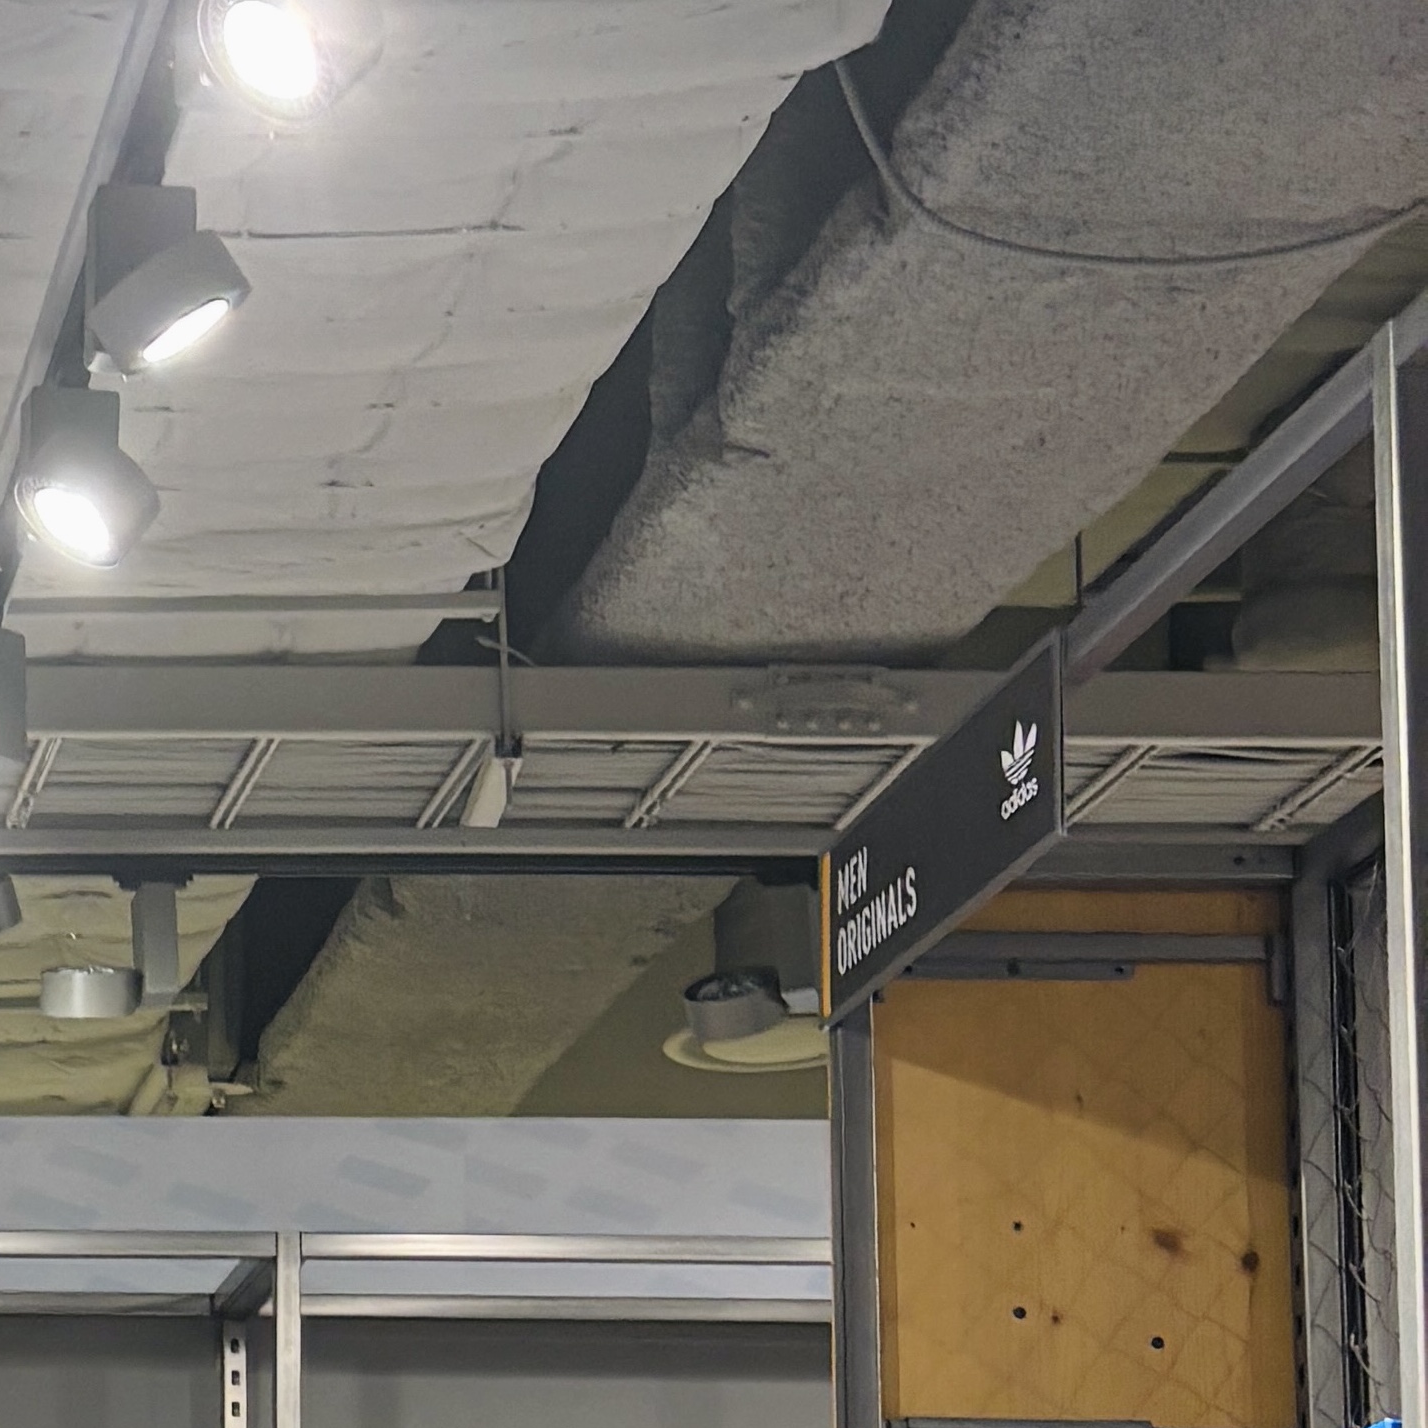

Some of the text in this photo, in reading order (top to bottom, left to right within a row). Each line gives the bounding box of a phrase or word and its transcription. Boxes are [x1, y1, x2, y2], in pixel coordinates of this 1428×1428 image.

[1001, 778, 1038, 820] adidas
[837, 846, 868, 916] MEN
[837, 866, 917, 976] ORIGINALS
